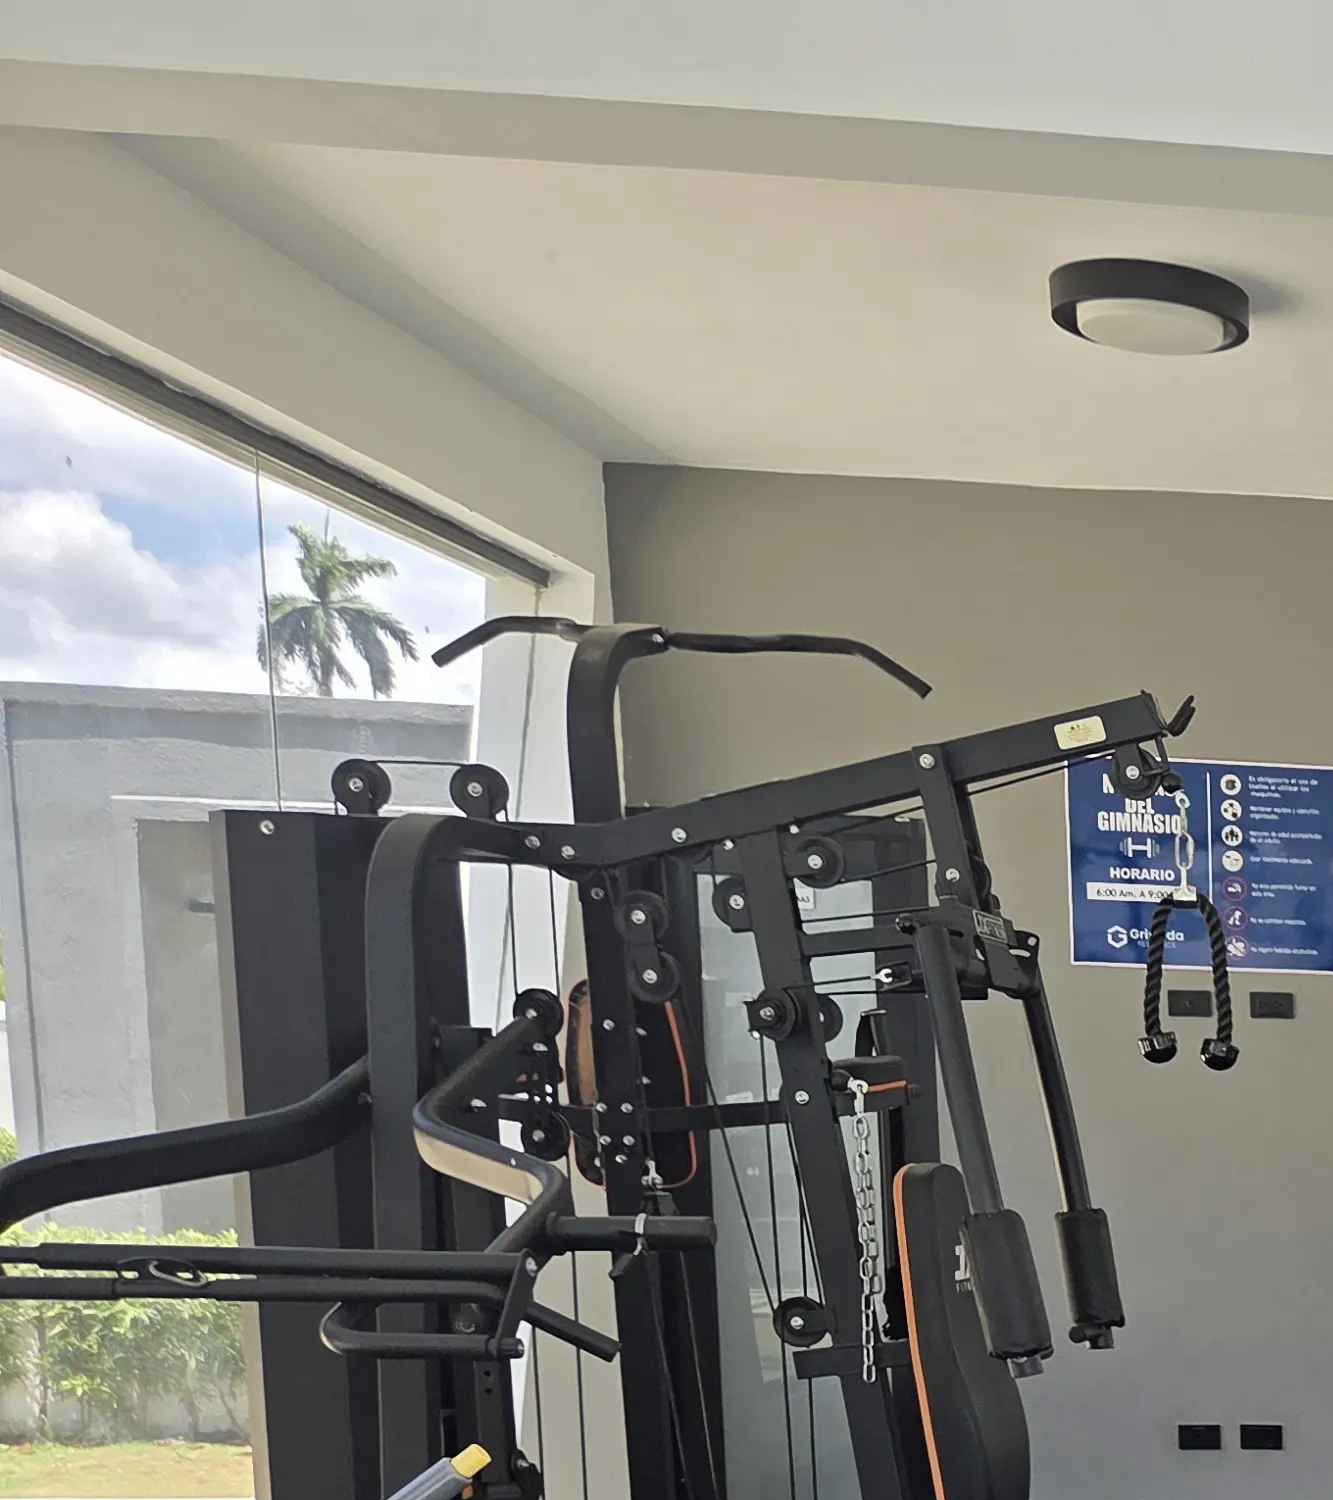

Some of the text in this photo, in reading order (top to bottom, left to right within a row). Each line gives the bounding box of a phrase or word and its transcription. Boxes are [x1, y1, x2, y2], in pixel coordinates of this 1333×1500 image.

[1097, 811, 1182, 834] GIMNASIO
[1110, 866, 1175, 881] HORARIO
[1096, 888, 1117, 897] 6:00
[1139, 890, 1146, 898] A
